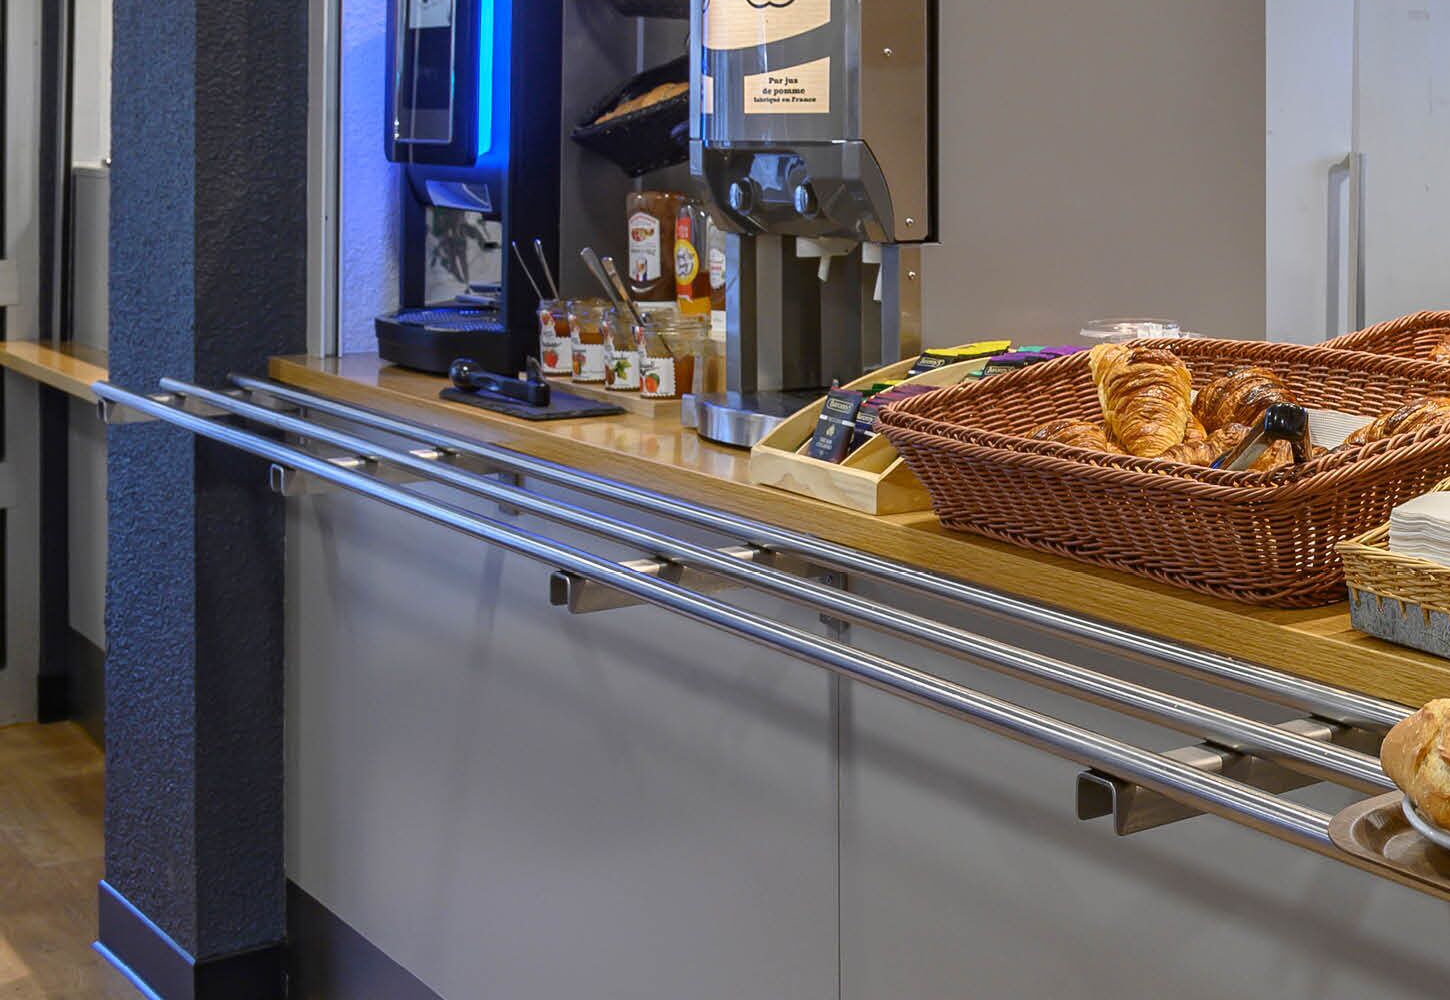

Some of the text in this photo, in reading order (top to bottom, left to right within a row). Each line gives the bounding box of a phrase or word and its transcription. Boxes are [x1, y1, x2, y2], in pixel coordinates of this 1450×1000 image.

[785, 76, 799, 86] jus
[762, 87, 806, 96] de pomme
